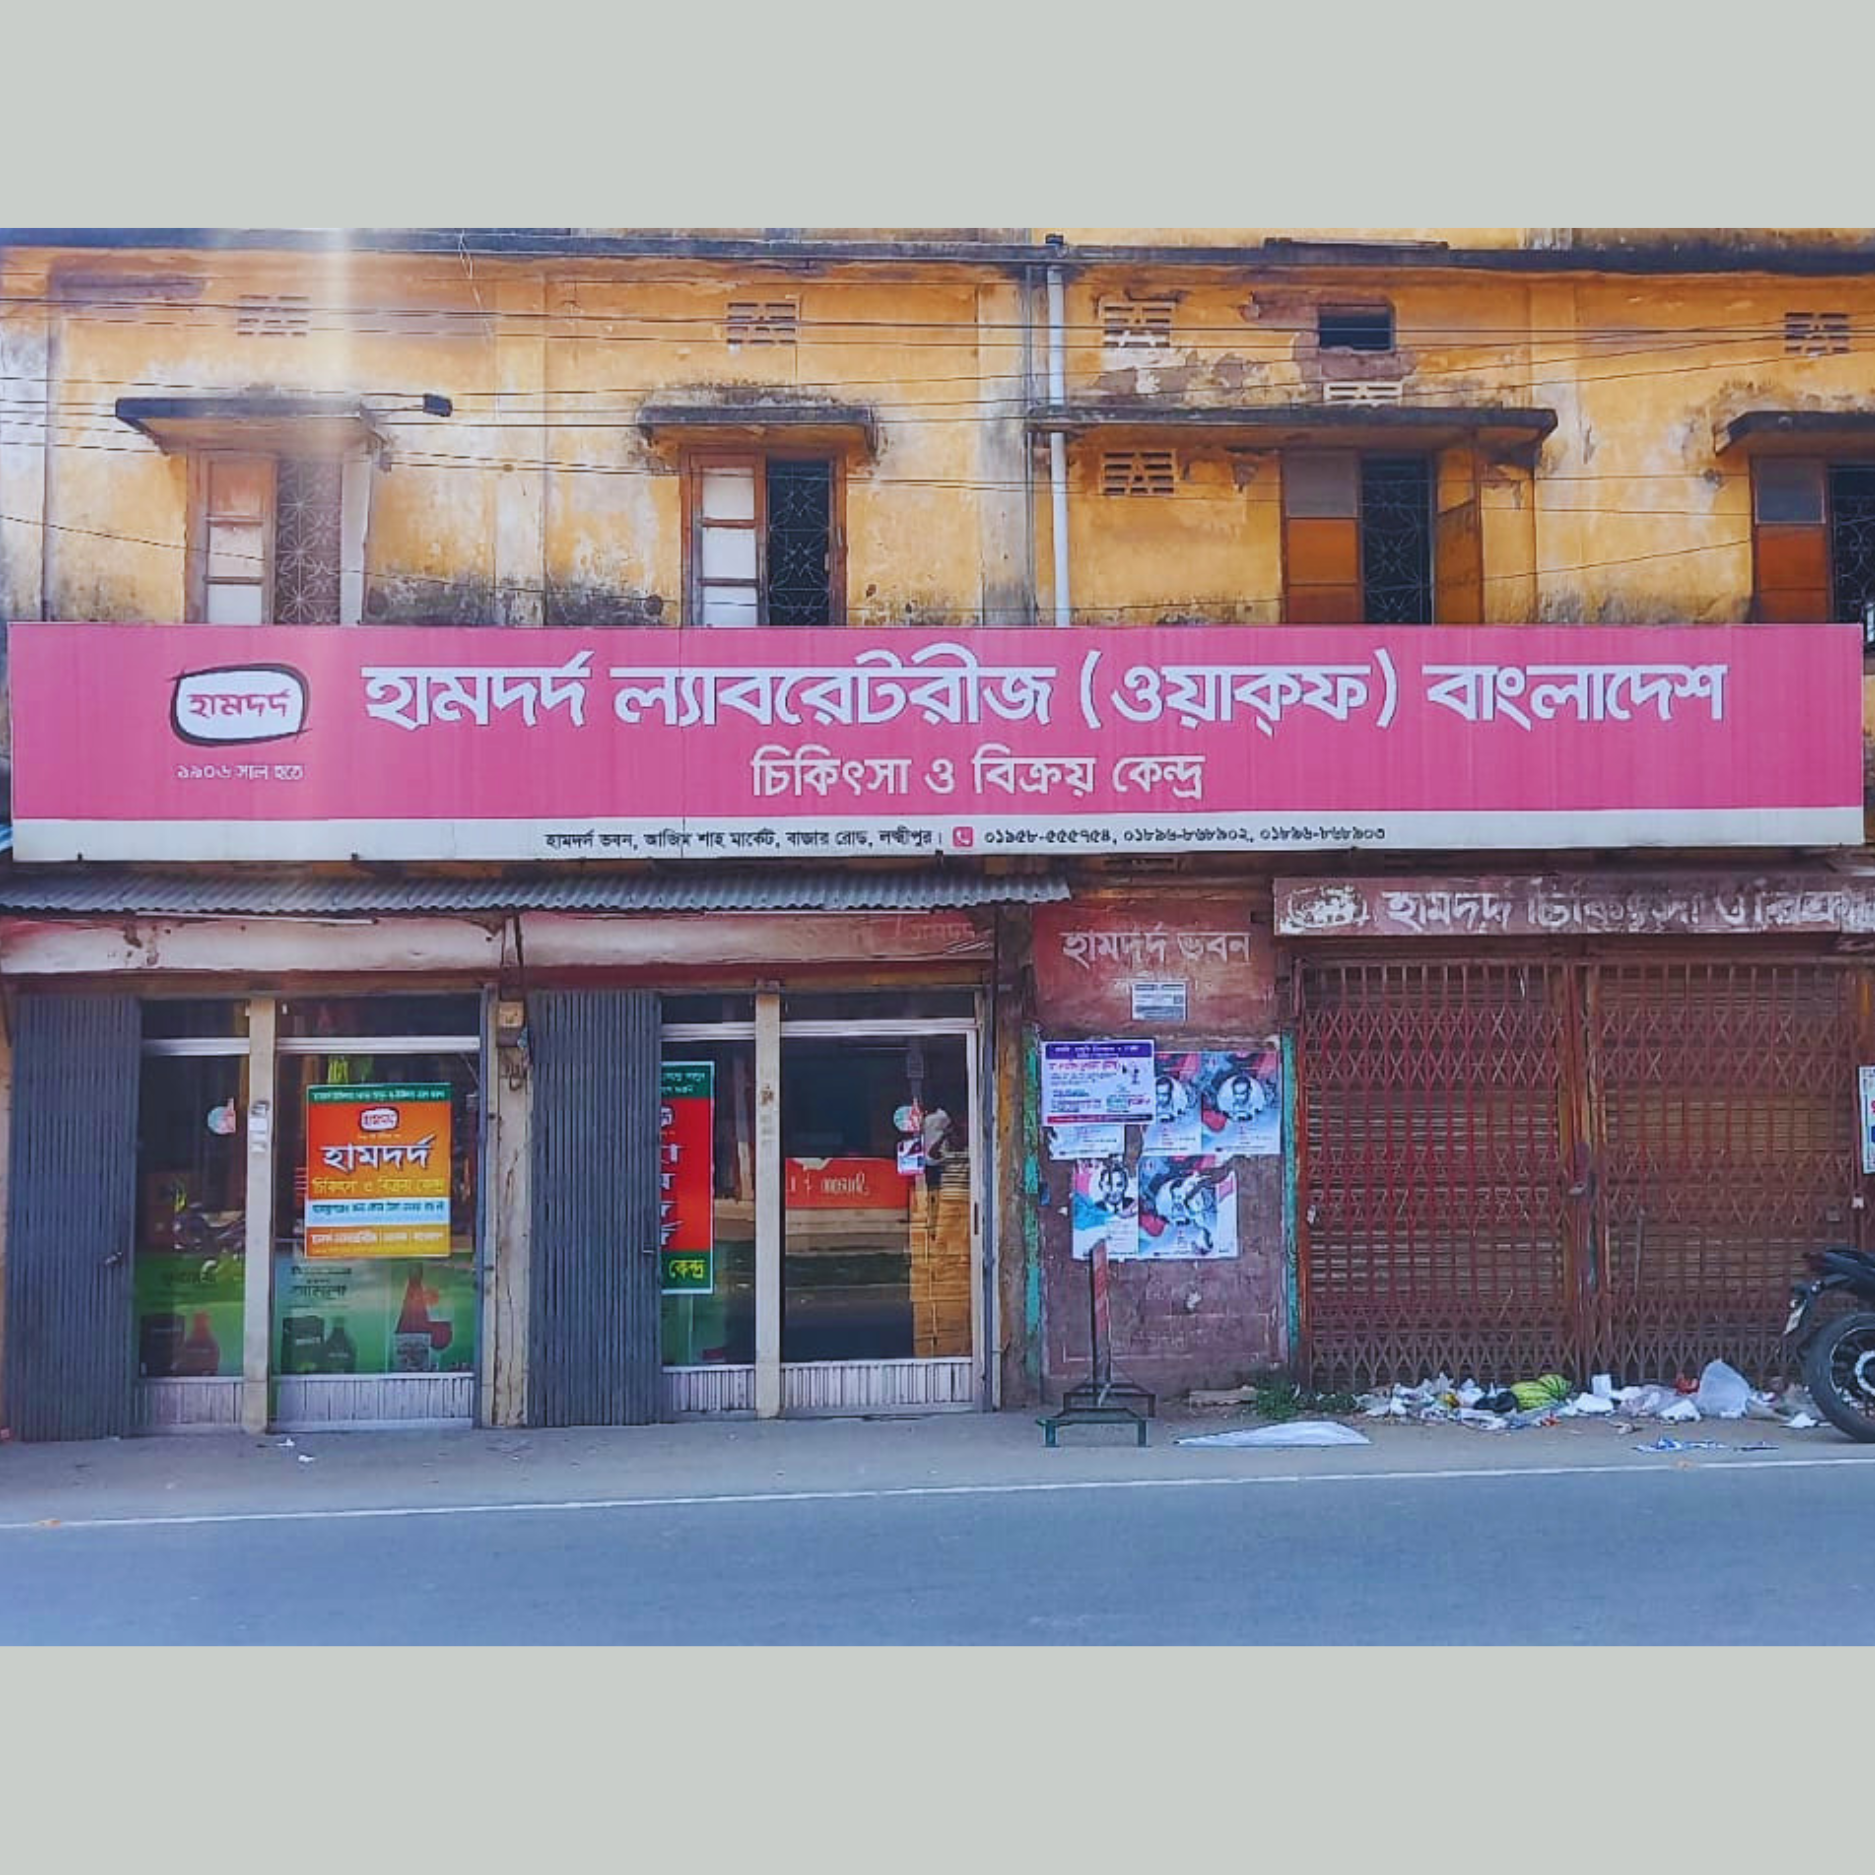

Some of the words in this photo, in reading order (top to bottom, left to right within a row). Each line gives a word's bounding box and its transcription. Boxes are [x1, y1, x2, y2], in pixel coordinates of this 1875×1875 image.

[186, 689, 291, 718] হামদর্দ
[361, 651, 594, 730] হামদর্দ
[610, 643, 1056, 726] ল্যাবরেটরীজ
[1422, 665, 1727, 730] বাংলাদেশ
[751, 745, 911, 796] চিকিৎসা
[925, 758, 954, 794] ও
[972, 744, 1096, 798] বিক্রয়
[1113, 755, 1205, 799] কেন্দ্র
[544, 829, 594, 848] হামদর্দ
[598, 834, 638, 850] ভবন,
[1060, 923, 1168, 969] হামদর্দ
[1177, 931, 1250, 963] ভবন
[320, 1134, 436, 1174] হামদর্দ
[668, 1258, 706, 1281] কেন্দ্র
